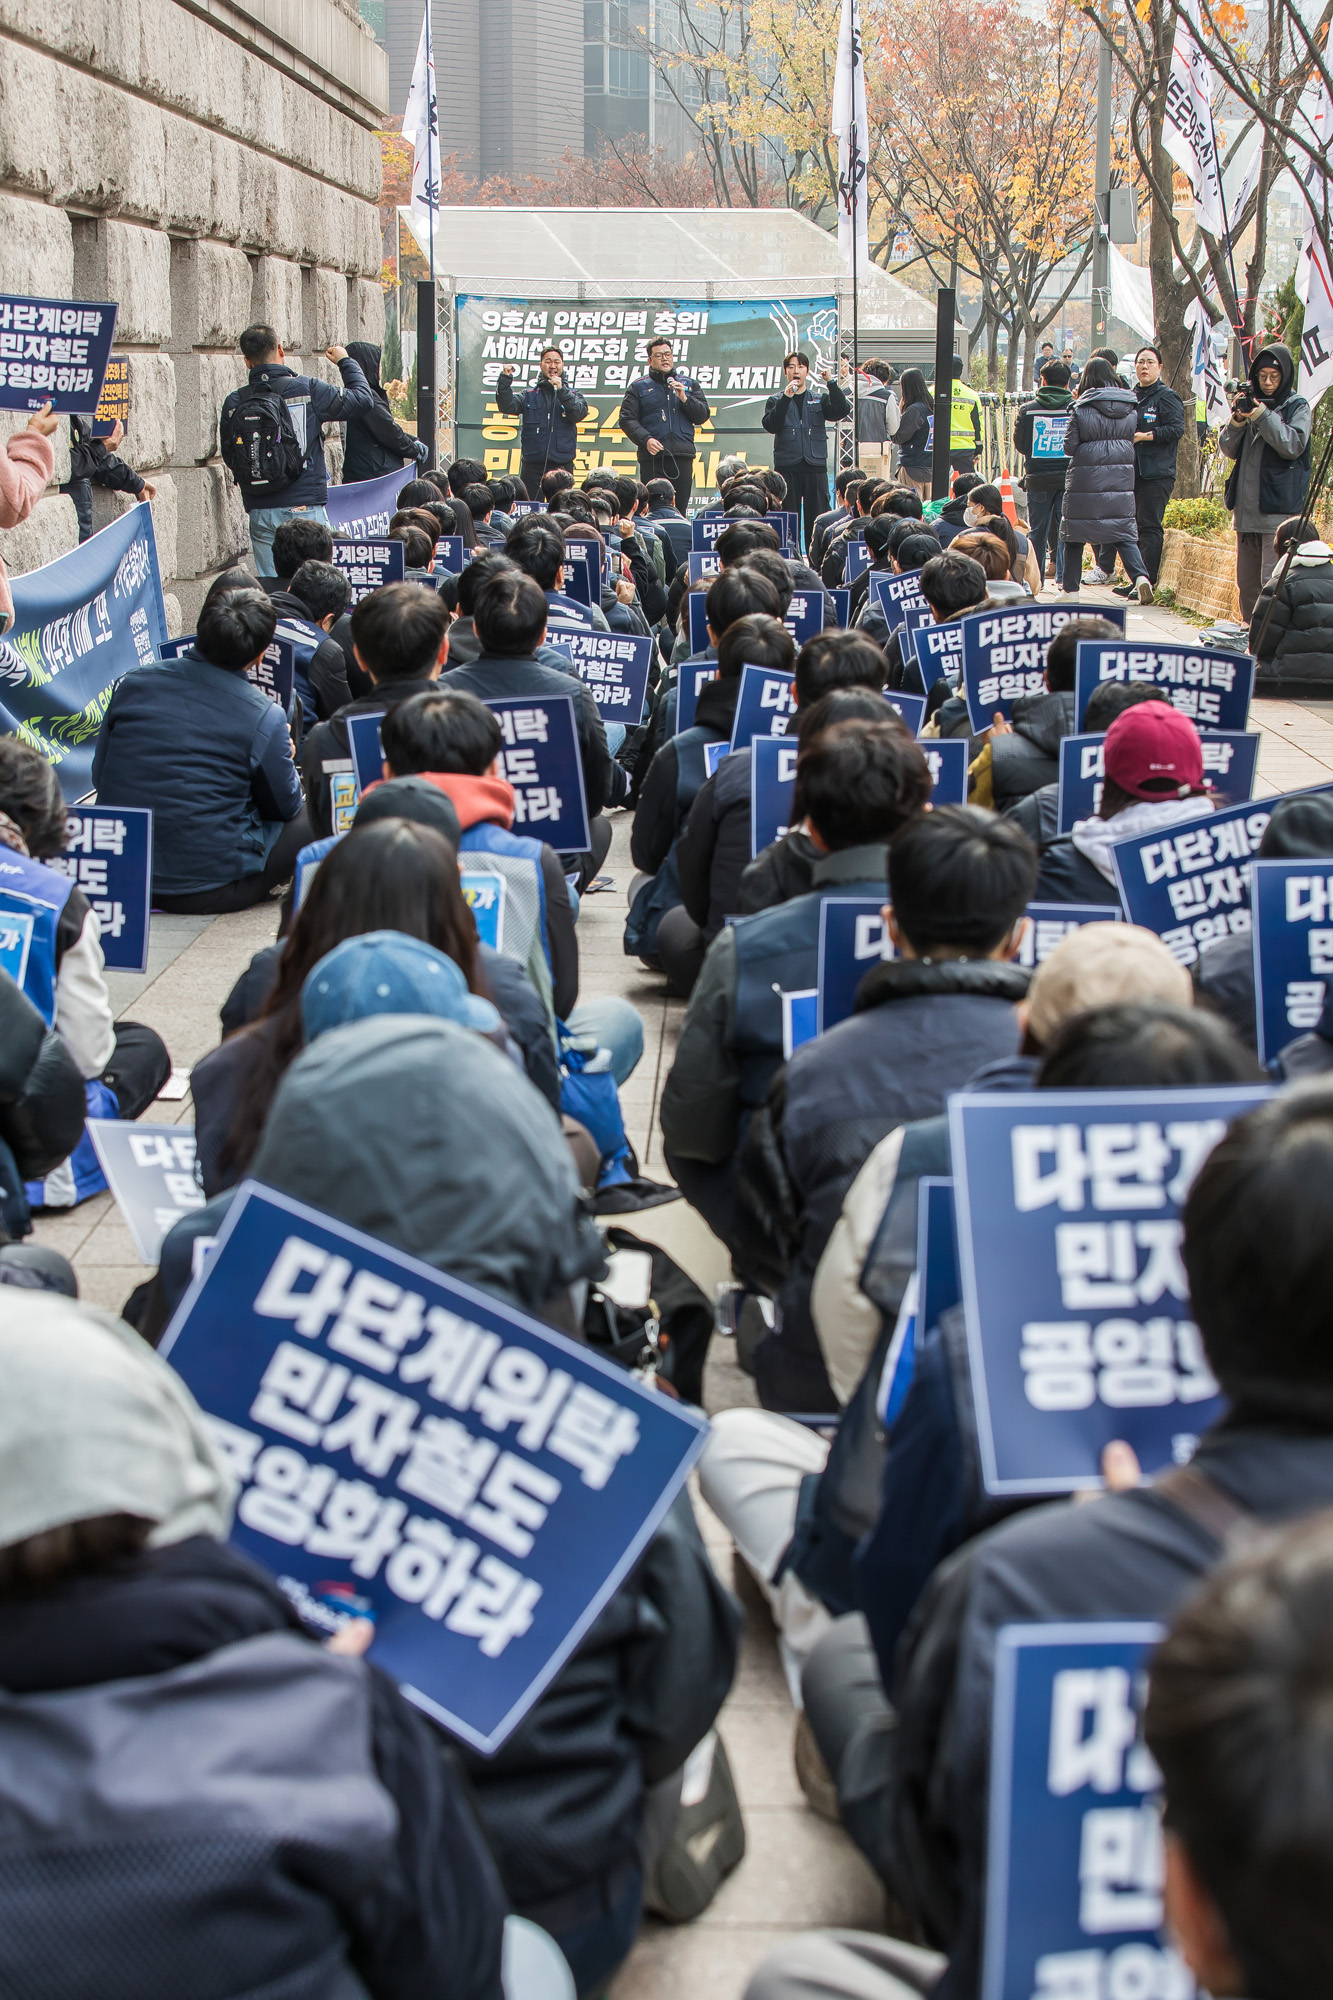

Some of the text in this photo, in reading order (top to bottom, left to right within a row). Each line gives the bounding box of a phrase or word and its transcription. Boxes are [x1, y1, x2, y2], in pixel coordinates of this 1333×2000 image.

[481, 310, 709, 336] 9호선 안전인력 충원!
[1, 332, 89, 364] 민자철도
[481, 335, 553, 361] 서해선
[726, 366, 782, 390] 저지!
[1099, 651, 1236, 692] 다단계위탁
[253, 1235, 640, 1490] 다단계위탁
[249, 1340, 562, 1559] 민자철도
